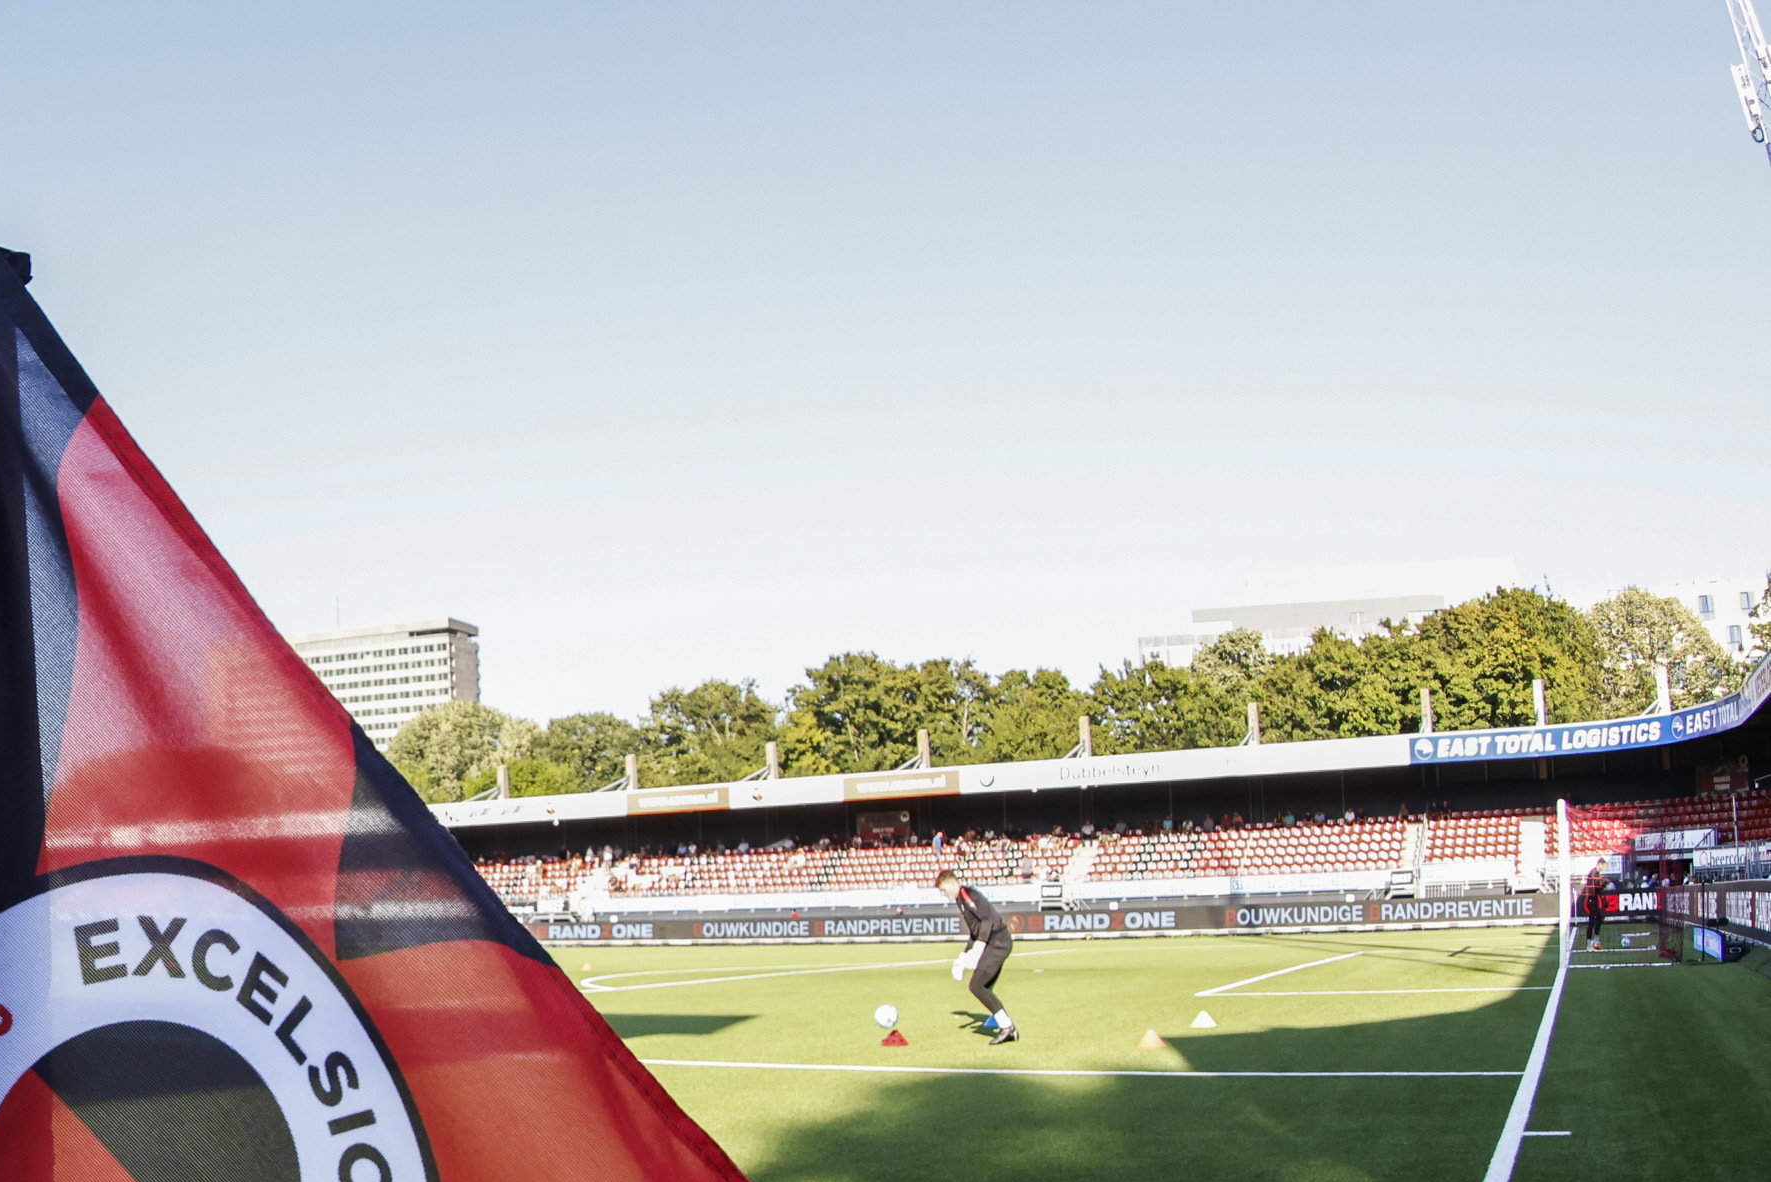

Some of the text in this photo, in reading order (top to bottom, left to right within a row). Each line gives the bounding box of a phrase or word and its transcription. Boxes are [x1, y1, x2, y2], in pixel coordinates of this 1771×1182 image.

[1686, 701, 1739, 735] EAST TOTAL
[1437, 721, 1662, 758] EAST TOTAL LOGISTICS
[694, 917, 961, 938] BOUWKUNDIGE BRANDPREVENTIE
[1227, 898, 1533, 926] BOUWKUNDIGE BRANDPREVENTIE
